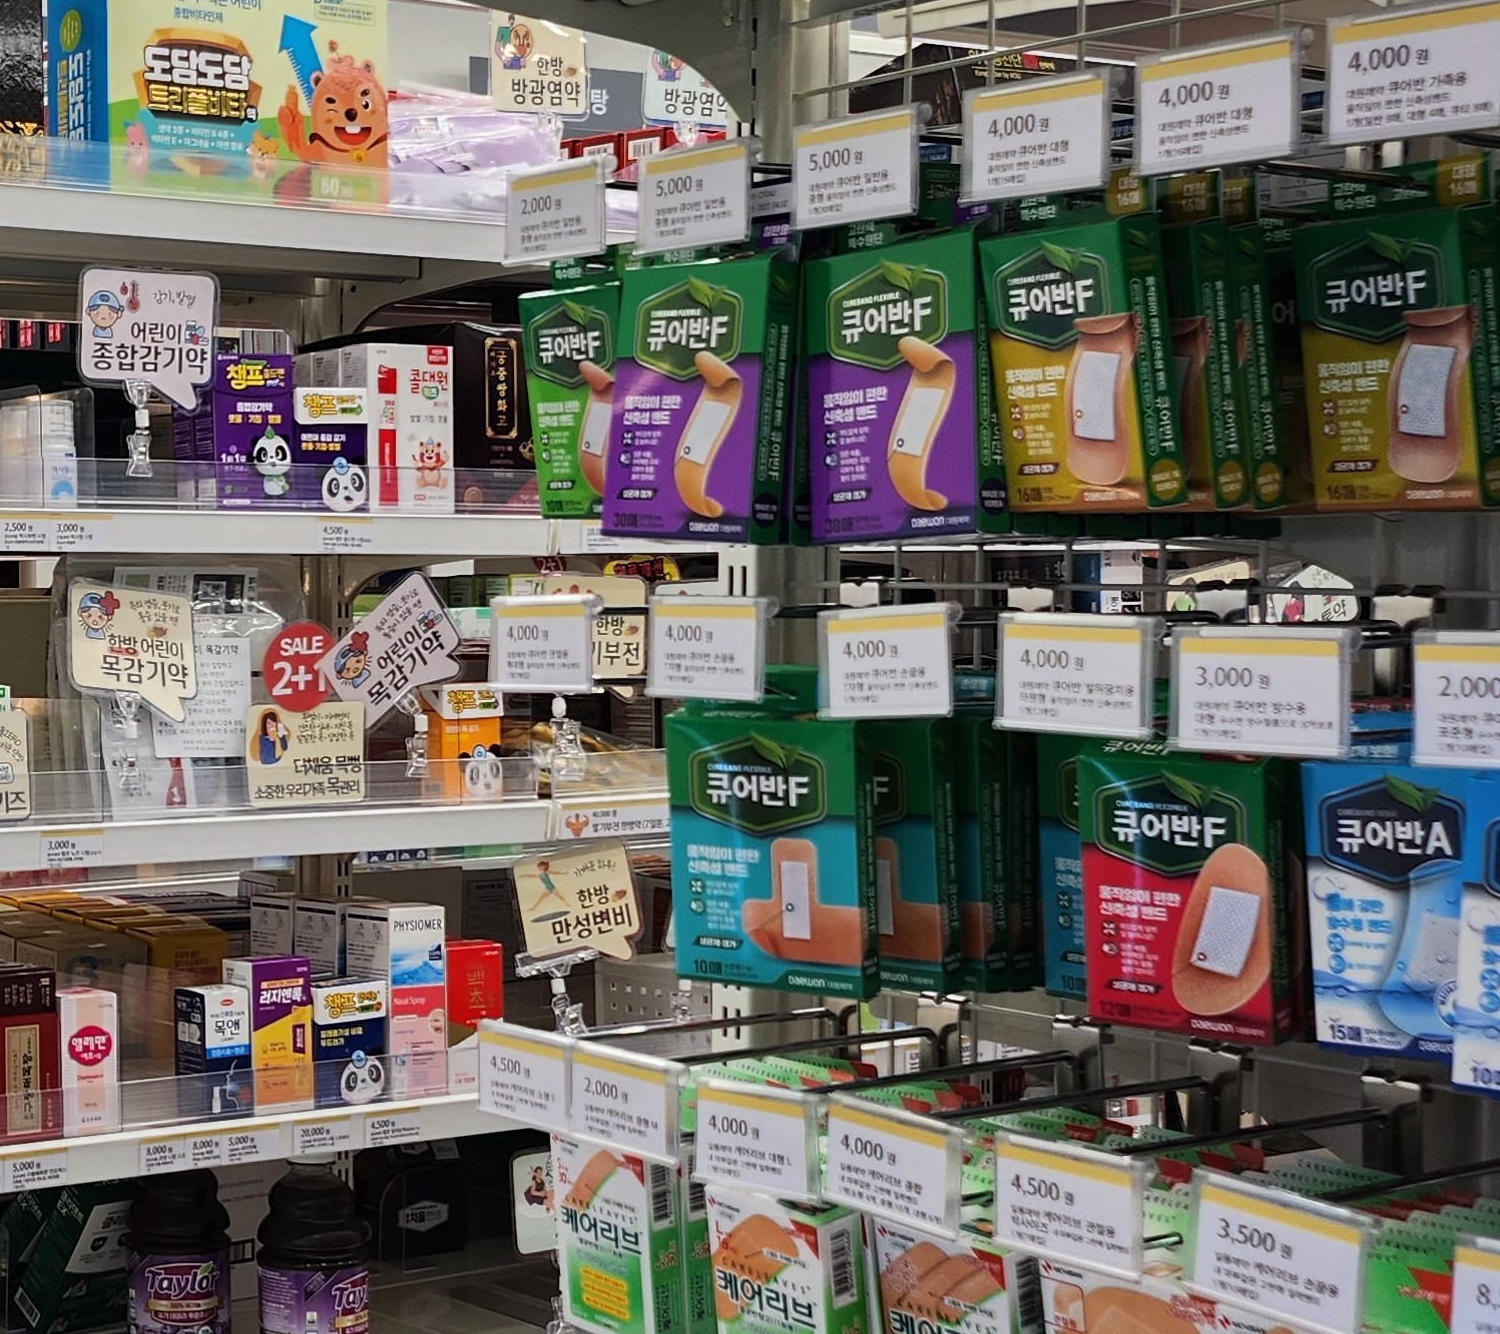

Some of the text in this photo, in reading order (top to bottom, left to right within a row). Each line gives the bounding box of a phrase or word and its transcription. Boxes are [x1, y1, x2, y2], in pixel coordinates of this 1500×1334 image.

[142, 44, 253, 91] 도담도담
[536, 56, 564, 78] 한방
[1349, 45, 1411, 73] 4,000
[146, 83, 248, 120] 트리플비타
[511, 78, 581, 108] 방광염약
[1158, 81, 1214, 108] 4,000
[988, 114, 1035, 139] 4,000
[809, 149, 851, 173] 5,000
[655, 176, 693, 198] 5,000
[520, 195, 552, 215] 2,000
[1008, 277, 1095, 321] 큐어반F
[1325, 269, 1428, 313] 큐어반F
[130, 322, 183, 345] 어린이
[646, 314, 730, 352] 큐어반F
[840, 295, 932, 345] 큐어반F
[91, 343, 208, 376] 종합감기약
[538, 327, 600, 365] 큐어반F
[409, 367, 449, 393] 콜대원
[506, 625, 539, 642] 4,000
[595, 616, 625, 637] 한방
[664, 625, 702, 644] 4,000
[107, 632, 185, 661] 한방 어린이
[205, 644, 239, 655] 목감기약
[280, 635, 324, 656] SALE
[376, 624, 423, 670] 어린이
[843, 640, 885, 661] 4,000
[1019, 649, 1069, 669] 4,000
[100, 654, 189, 689] 목감기약
[272, 661, 327, 697] 2+1
[366, 629, 445, 707] 목감기약
[1194, 666, 1252, 689] 3,000
[705, 770, 810, 808] 큐어반F
[1111, 809, 1227, 849] 큐어반F
[1335, 818, 1455, 857] 큐어반A
[576, 883, 610, 908] 한방
[393, 918, 443, 933] PHYSIOMER
[550, 903, 634, 944] 만성변비
[584, 1076, 618, 1101] 2,000
[708, 1114, 748, 1137] 4,000
[840, 1134, 884, 1161] 4,000
[1010, 1173, 1060, 1202] 4,500
[560, 1205, 642, 1256] 케어리브
[1216, 1218, 1276, 1253] 3,500
[146, 1266, 220, 1292] Taylor
[716, 1268, 817, 1329] 케어리브
